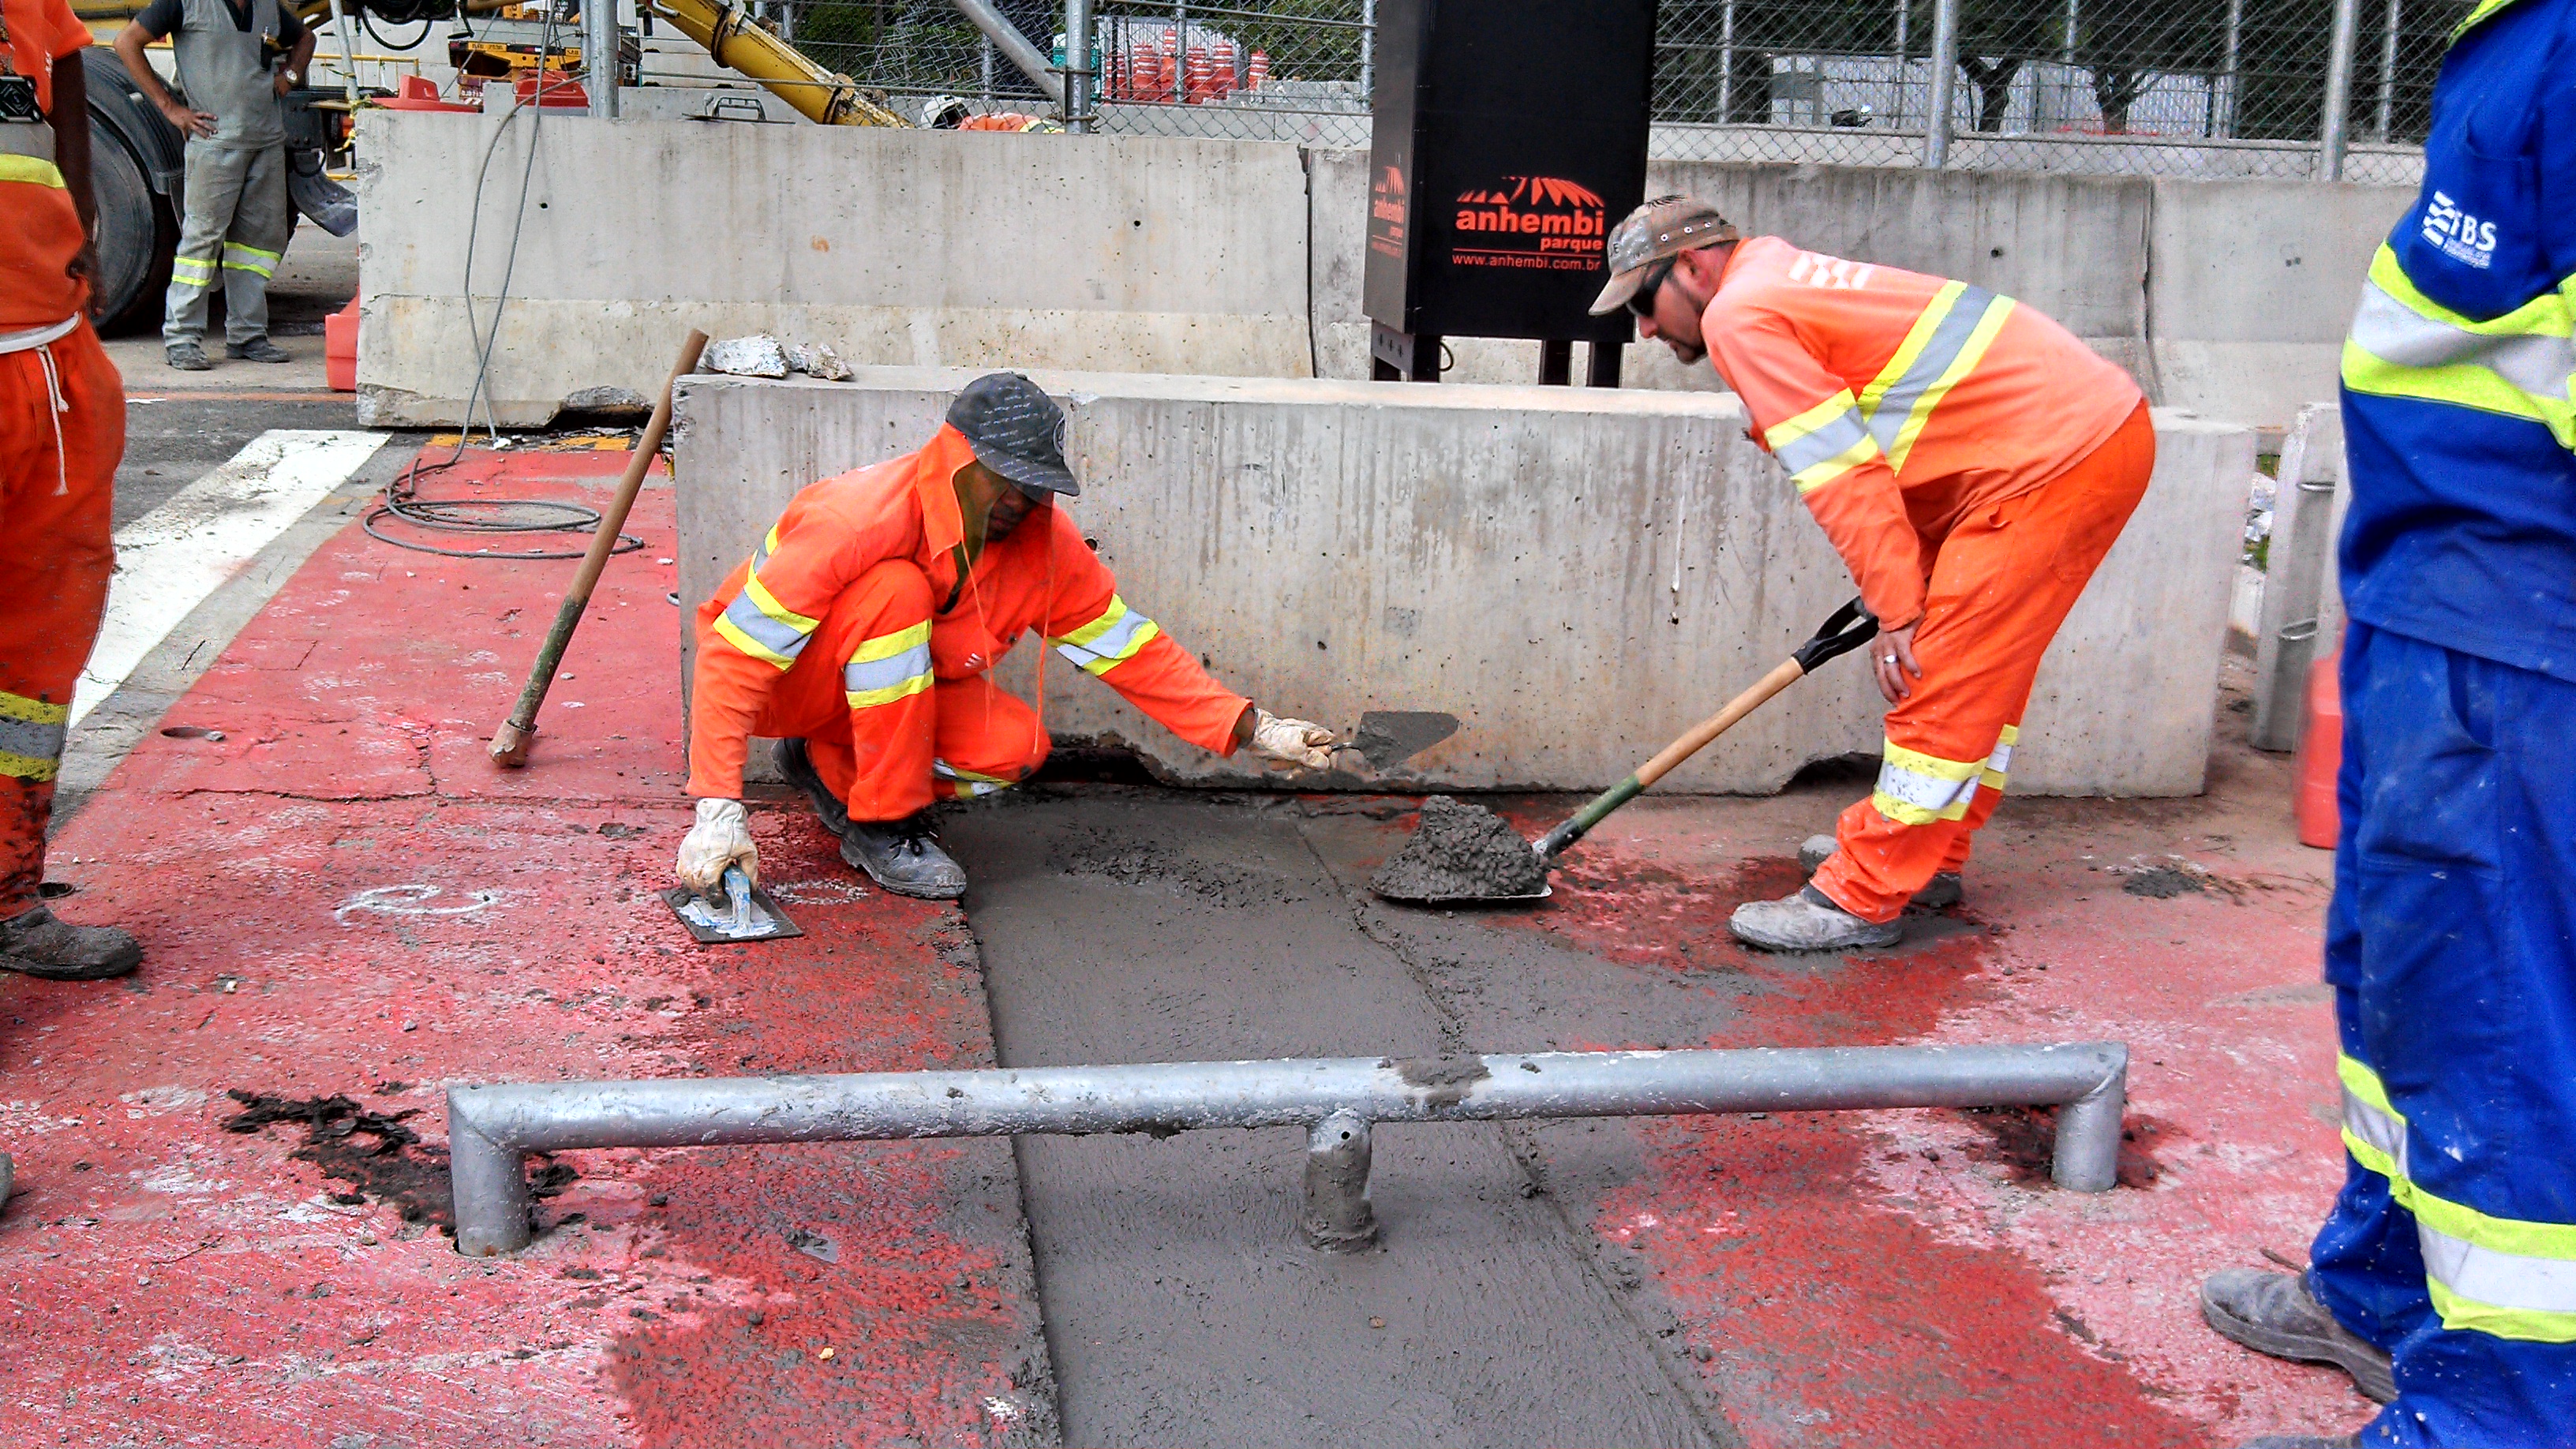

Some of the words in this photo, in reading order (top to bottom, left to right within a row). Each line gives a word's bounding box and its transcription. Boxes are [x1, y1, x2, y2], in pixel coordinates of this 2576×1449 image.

[1455, 206, 1604, 235] anhembi
[1541, 237, 1604, 252] parque
[1452, 254, 1601, 271] www.anhembi.com.br
